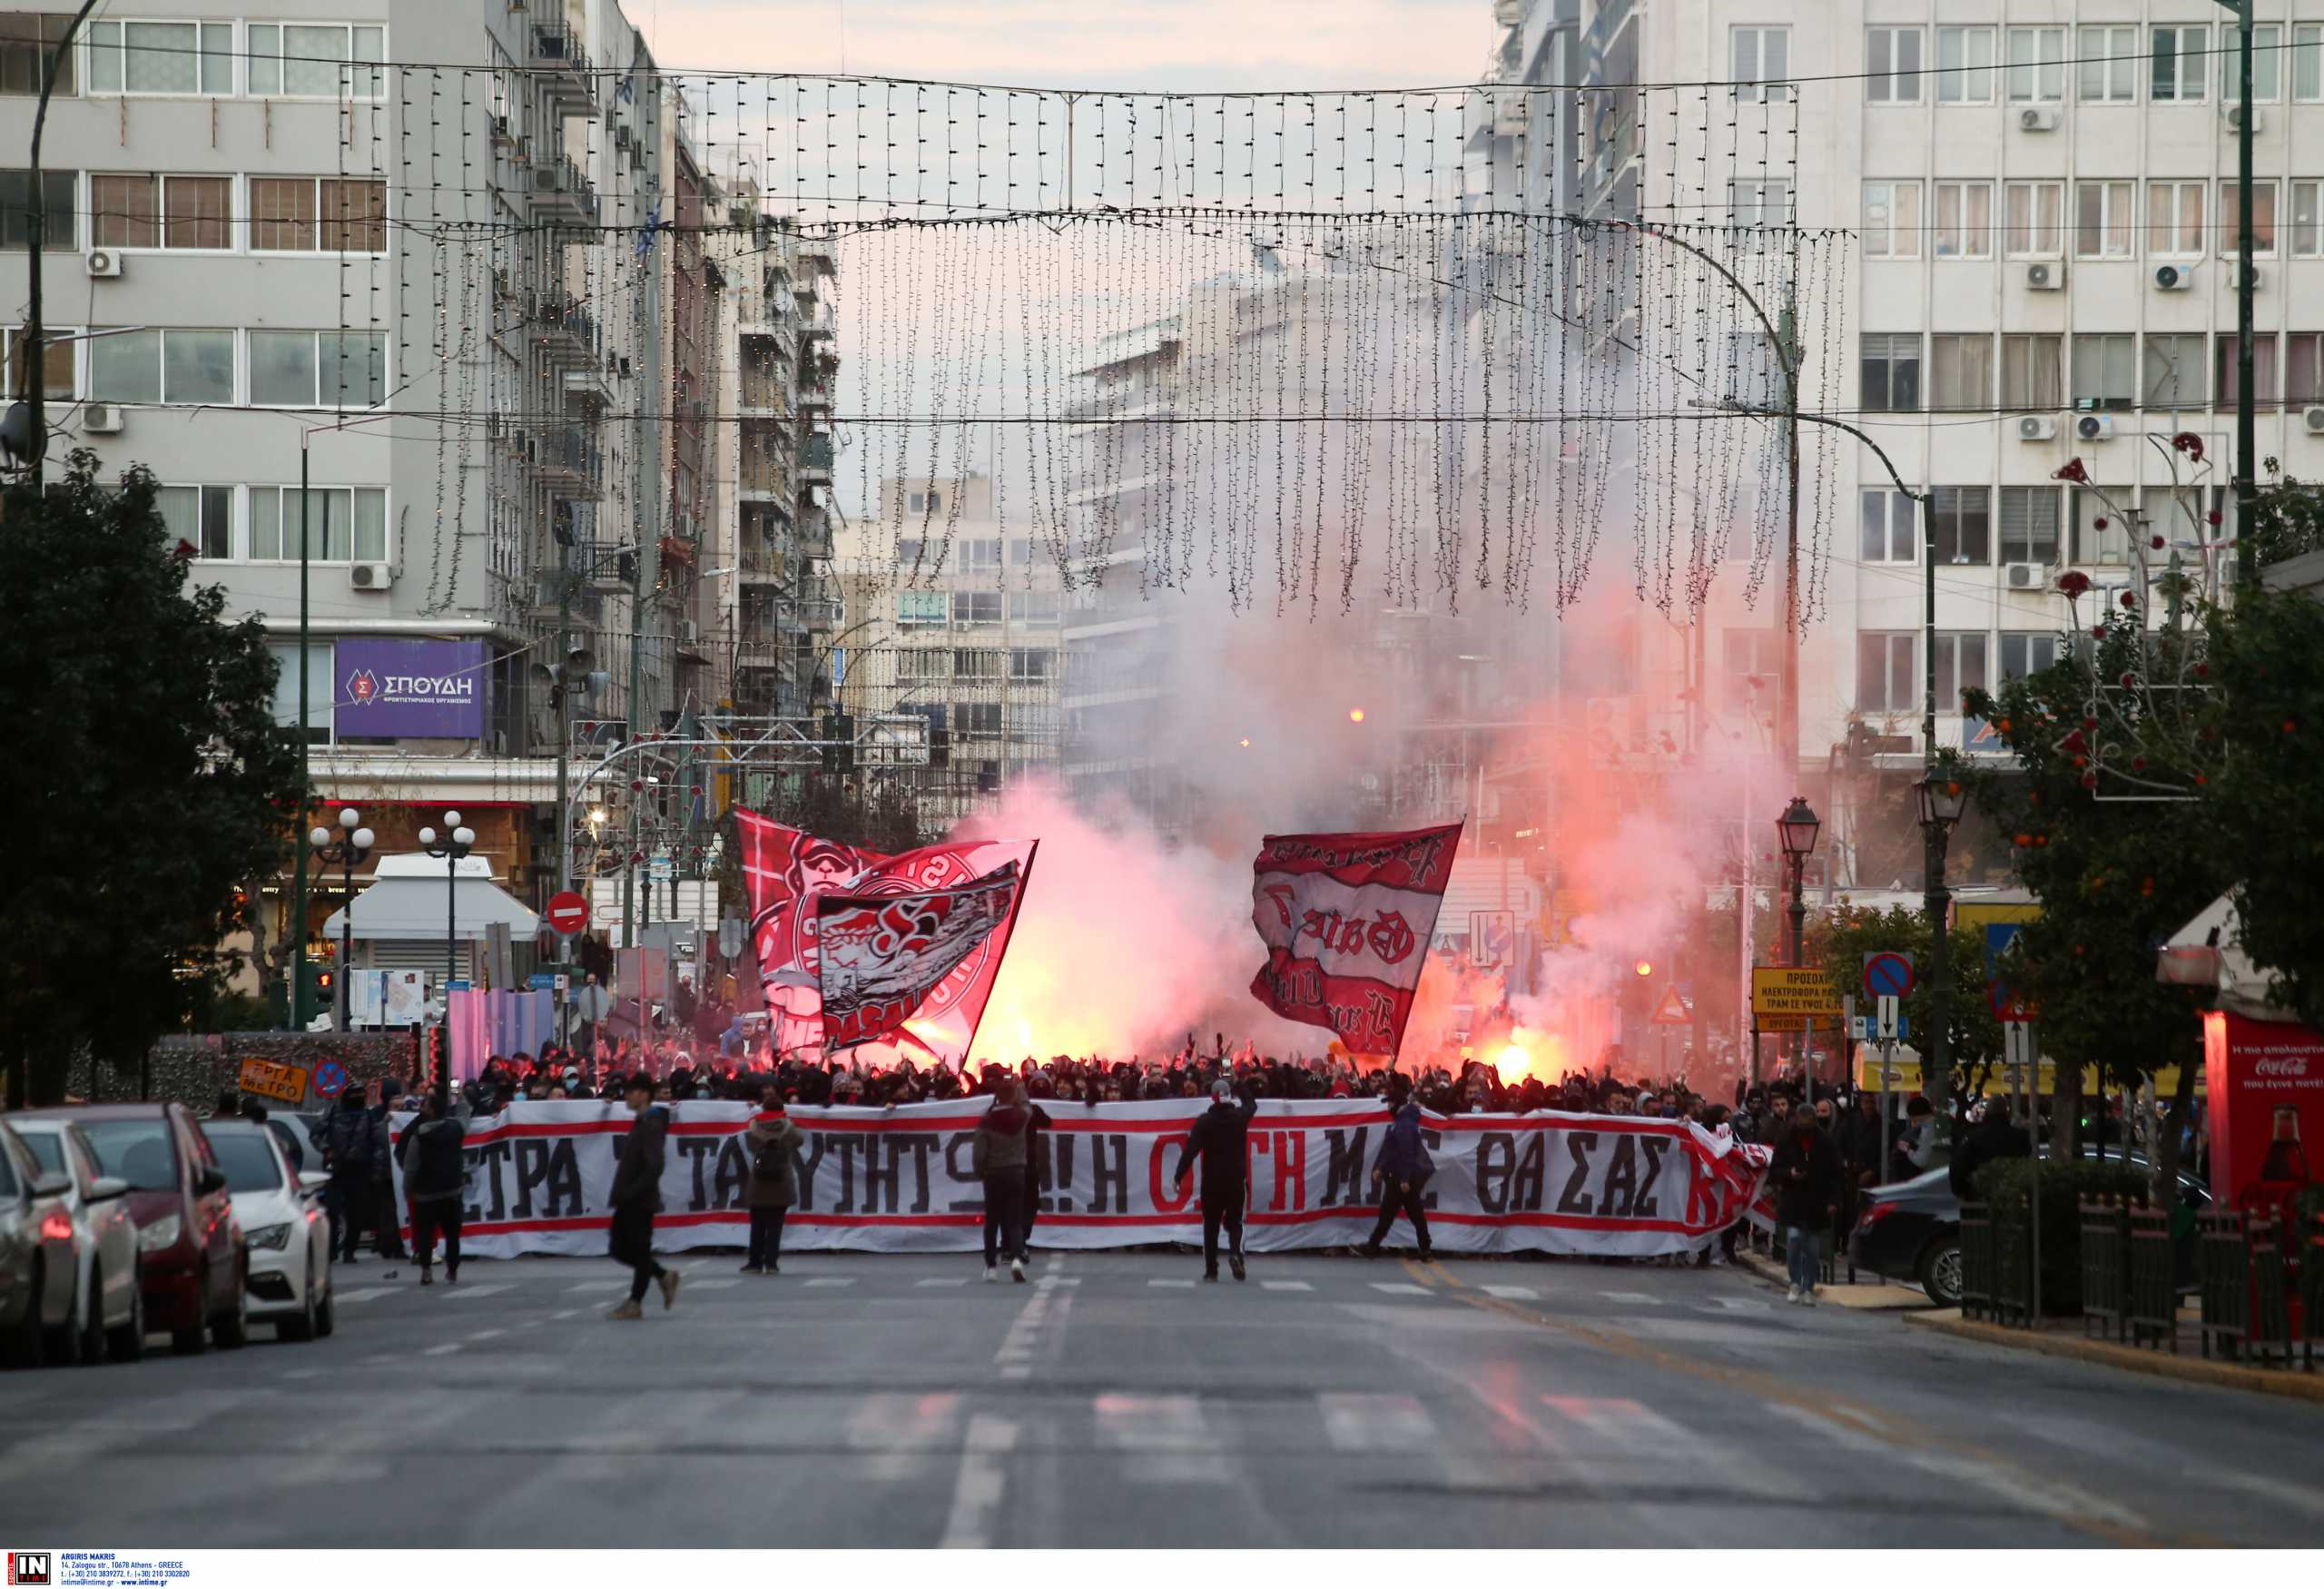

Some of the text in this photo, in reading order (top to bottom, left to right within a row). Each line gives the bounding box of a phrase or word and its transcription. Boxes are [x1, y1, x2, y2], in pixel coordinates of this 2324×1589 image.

[384, 676, 472, 696] ΣΠΟΥΔΗ
[1762, 987, 1819, 997] ΗΛΕΚΤΡΟΦΟΡΑ
[1767, 1000, 1788, 1010] ΤΡΑΜ
[242, 1076, 298, 1098] ΜΕΤΡΟ
[1149, 1130, 1306, 1213] ΟΓΗ
[1476, 1130, 1545, 1214] ΘΑ
[1556, 1131, 1671, 1218] ΣΑΣ
